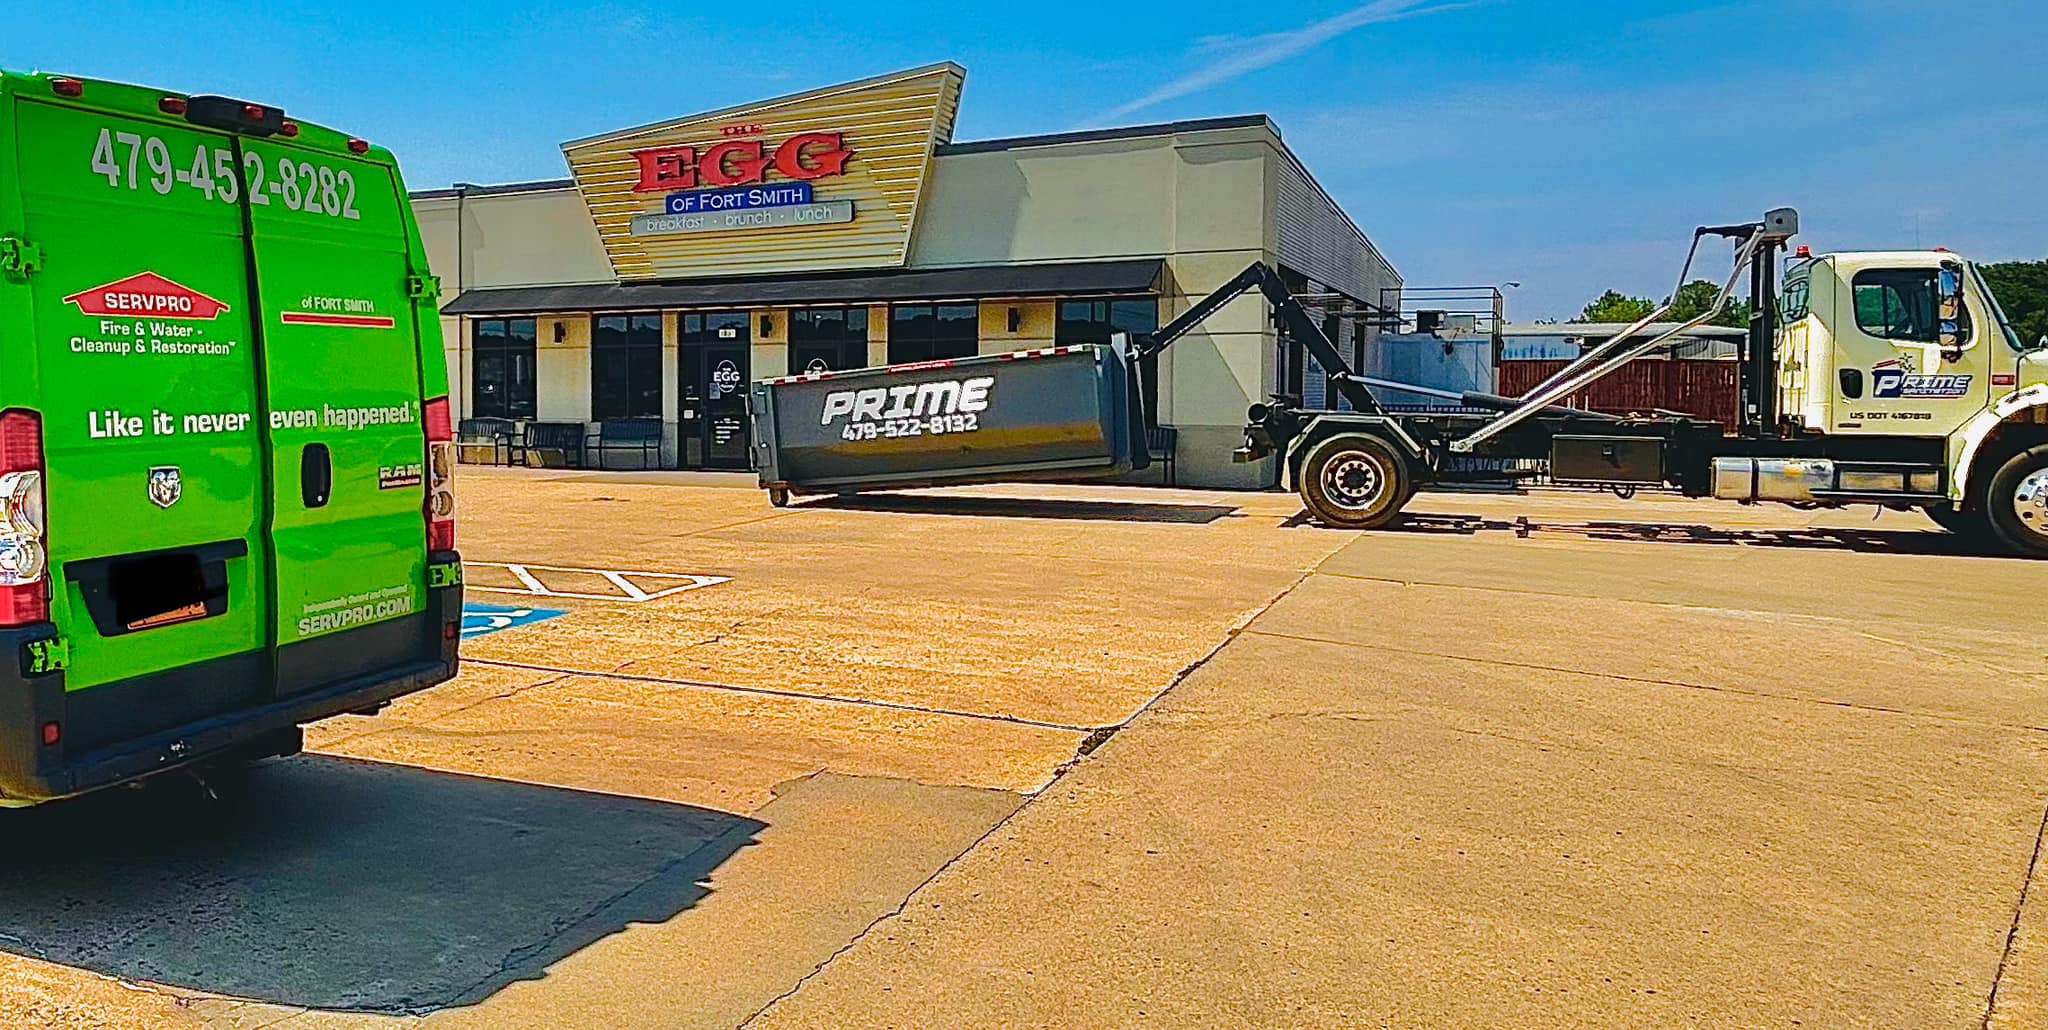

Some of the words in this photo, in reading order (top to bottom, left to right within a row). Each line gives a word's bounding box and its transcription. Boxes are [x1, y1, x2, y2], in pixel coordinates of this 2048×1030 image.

[91, 127, 361, 220] 479-452-8282
[629, 132, 857, 194] EGG
[672, 198, 695, 212] OF
[700, 194, 746, 210] FORT
[749, 189, 803, 206] SMITH
[646, 217, 705, 232] breakfast
[725, 211, 773, 227] brunch
[794, 206, 833, 223] lunch
[301, 295, 313, 309] of
[314, 296, 343, 311] FORT
[344, 298, 375, 313] SMITH
[100, 320, 130, 336] Fire
[134, 321, 145, 336] &
[150, 321, 194, 337] Water
[70, 337, 131, 356] Cleanup
[135, 338, 147, 353] &
[713, 371, 741, 382] EGG
[1875, 375, 1972, 396] PRIME
[821, 376, 995, 425] PRIME
[88, 410, 144, 438] Like
[152, 409, 175, 435] it
[183, 412, 251, 434] never
[270, 409, 318, 429] even
[323, 401, 415, 431] happened.
[841, 413, 979, 441] 479-522-8132
[1850, 412, 1865, 420] US
[1867, 412, 1888, 420] DOT
[380, 464, 422, 479] RAM
[299, 596, 412, 636] SERVPRO.COM
